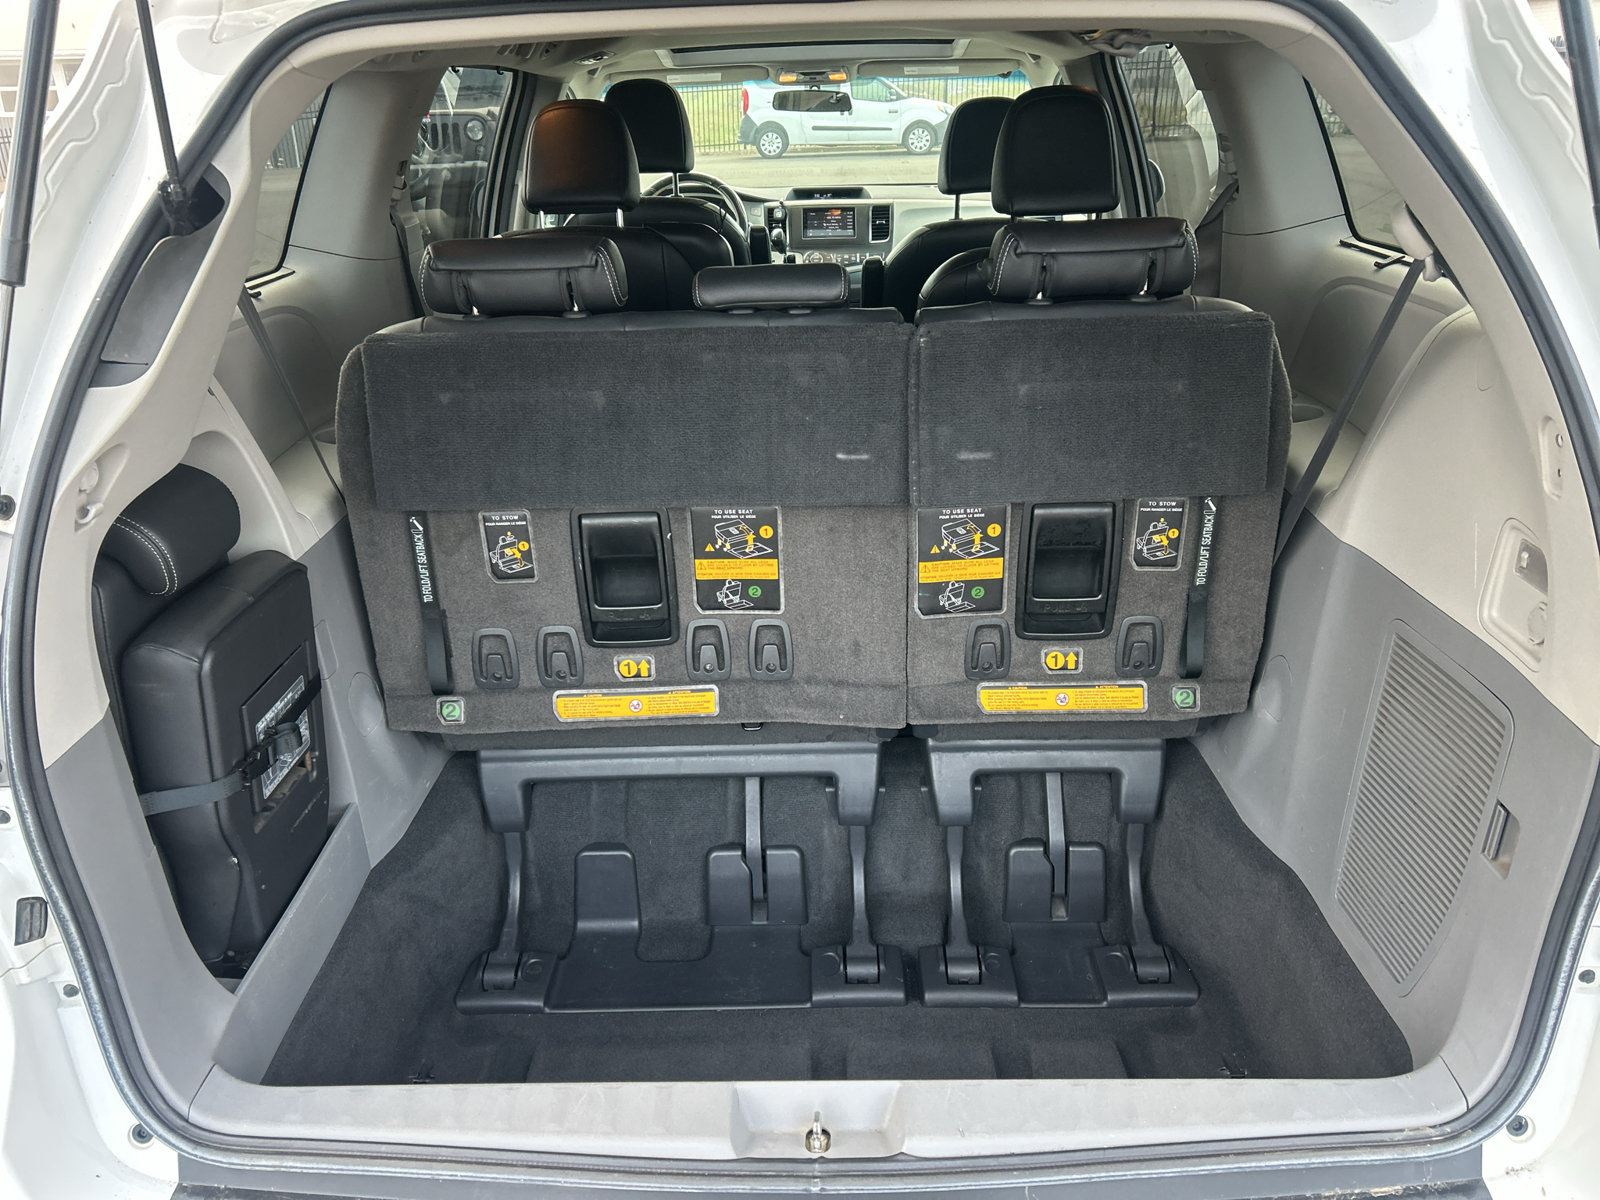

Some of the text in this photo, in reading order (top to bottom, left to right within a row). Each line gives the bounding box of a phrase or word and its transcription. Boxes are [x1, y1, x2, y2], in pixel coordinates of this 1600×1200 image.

[413, 533, 434, 603] TO FOLD/LIFT SEATBACK
[1196, 514, 1215, 586] TO FOLD/LIFT SEATBACK
[445, 703, 457, 718] 2
[1179, 690, 1191, 705] 2
